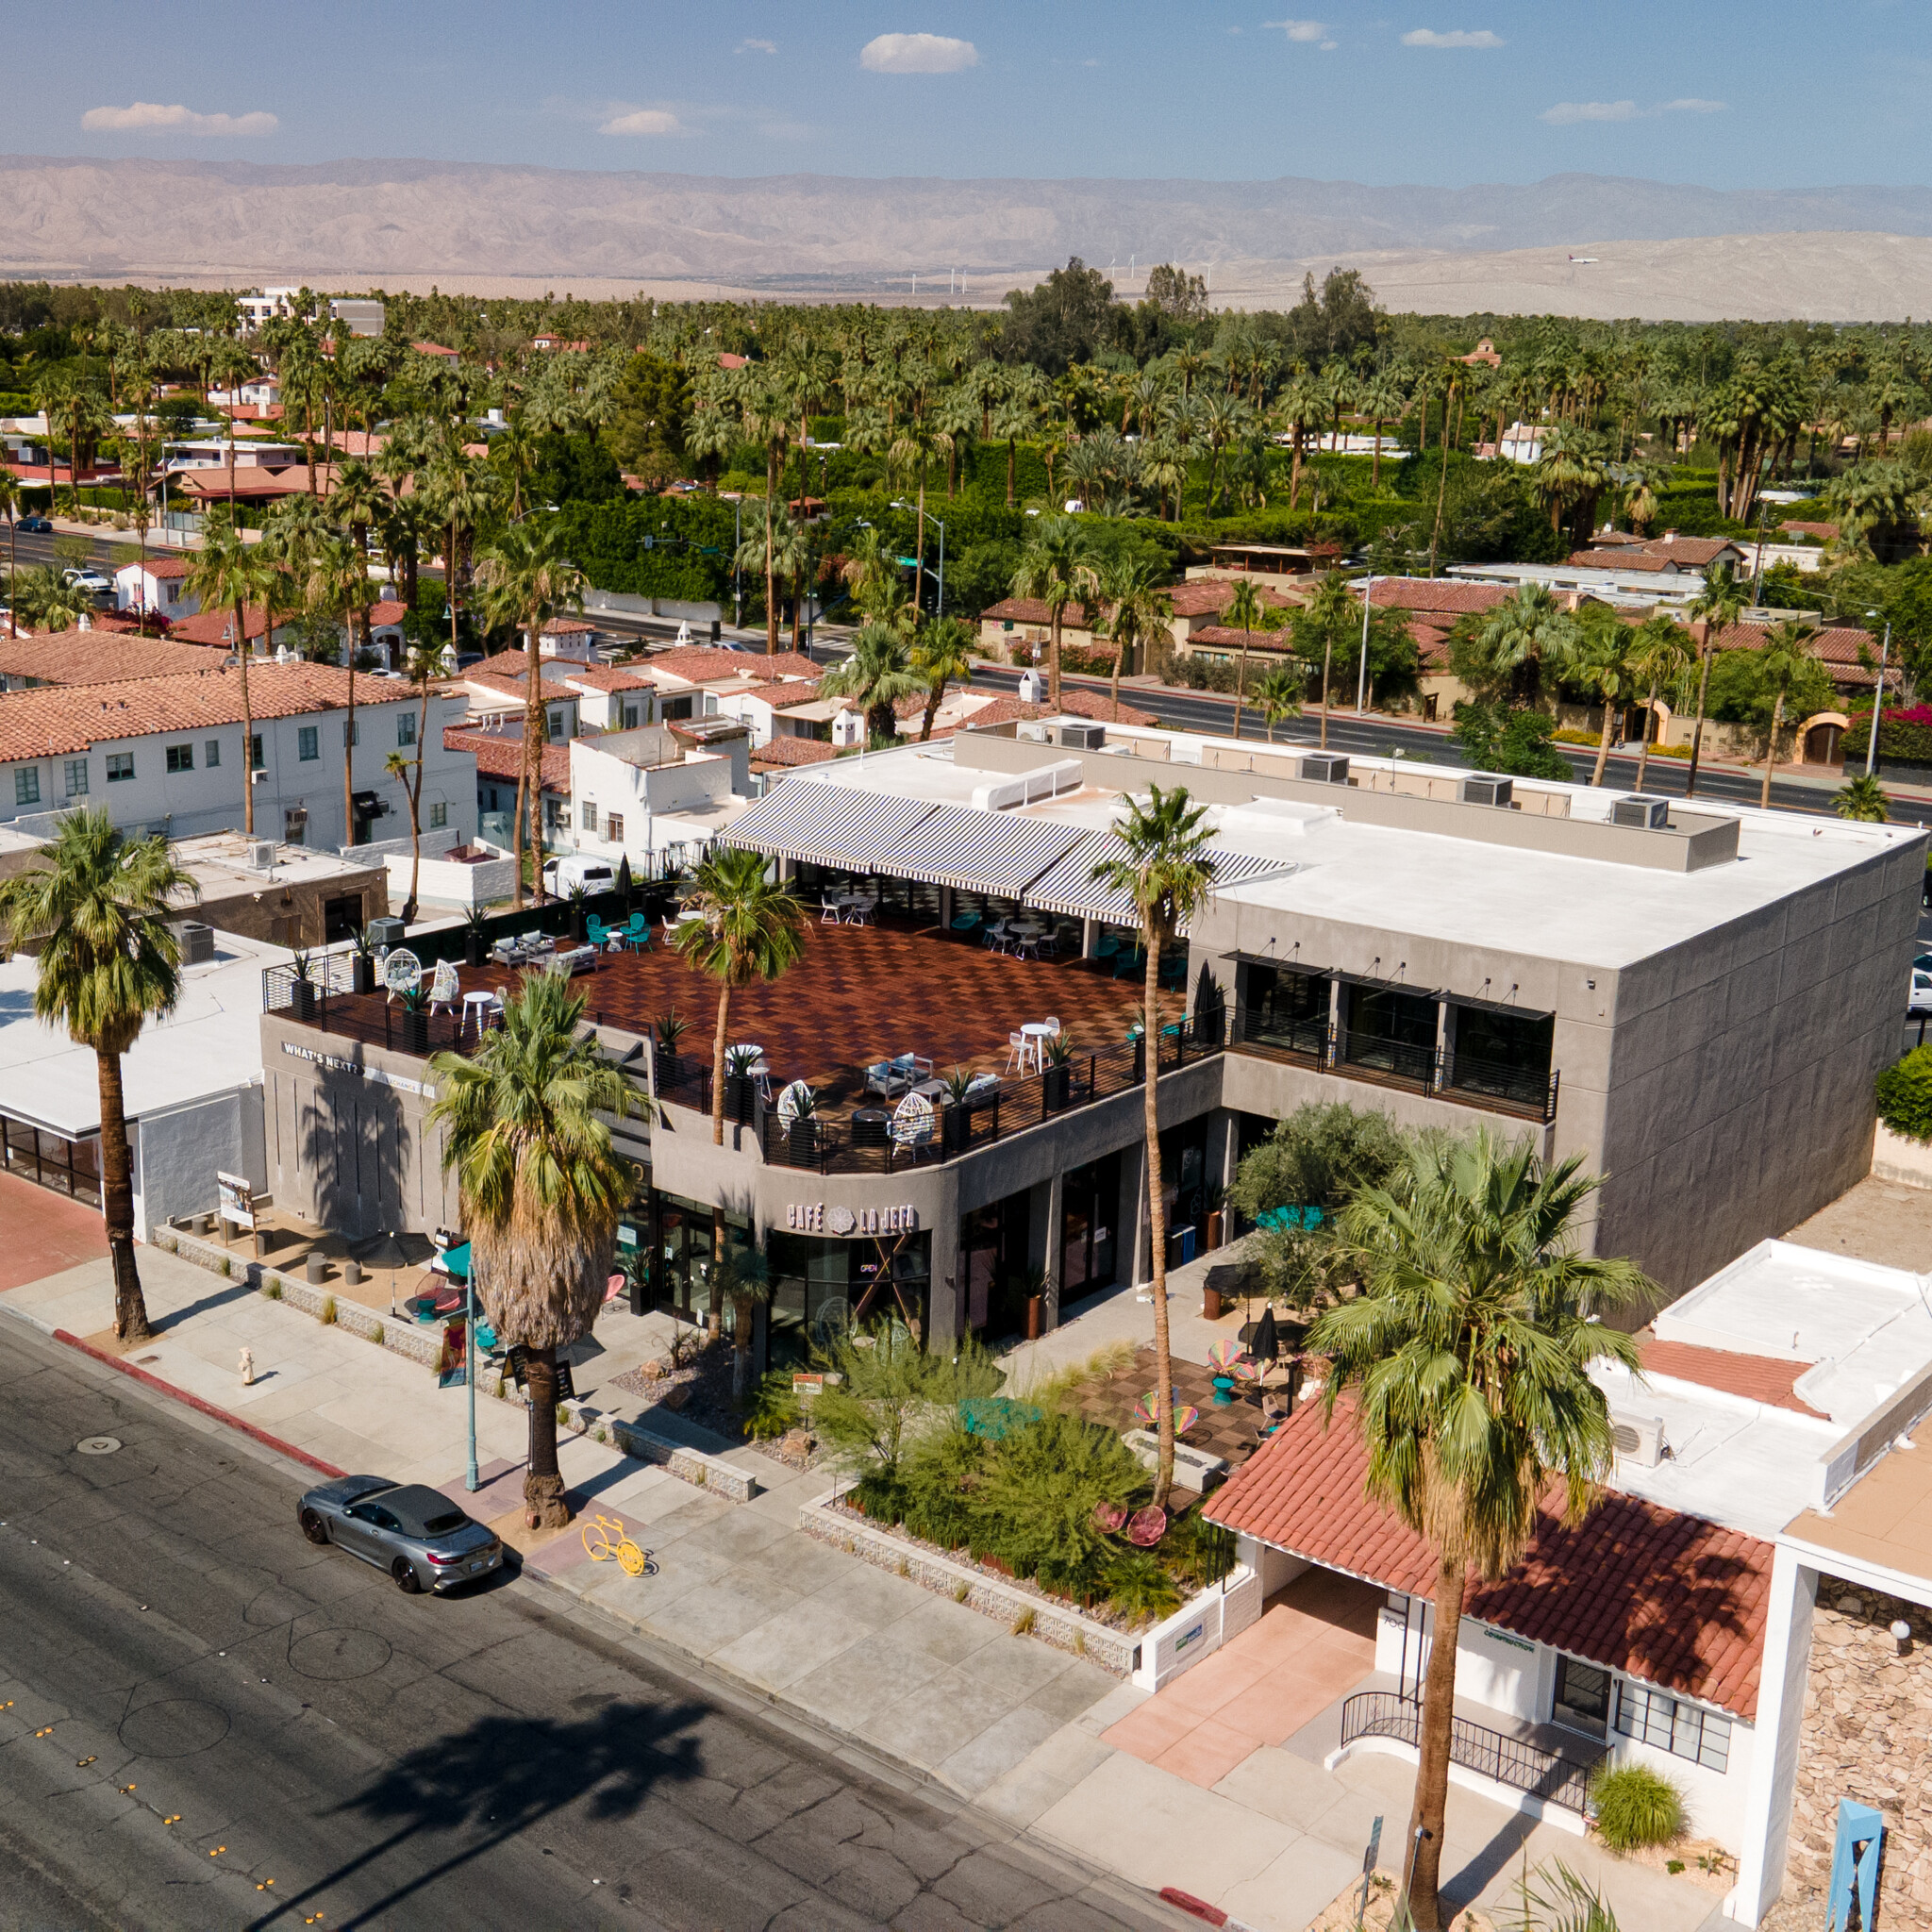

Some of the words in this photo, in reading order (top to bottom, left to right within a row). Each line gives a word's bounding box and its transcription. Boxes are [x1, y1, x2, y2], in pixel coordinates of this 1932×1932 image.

[283, 1041, 324, 1064] WHAT'S
[325, 1055, 358, 1075] NEXT?
[786, 1202, 824, 1231] CAFÉ
[859, 1208, 877, 1232] LA
[880, 1204, 916, 1231] JEFA
